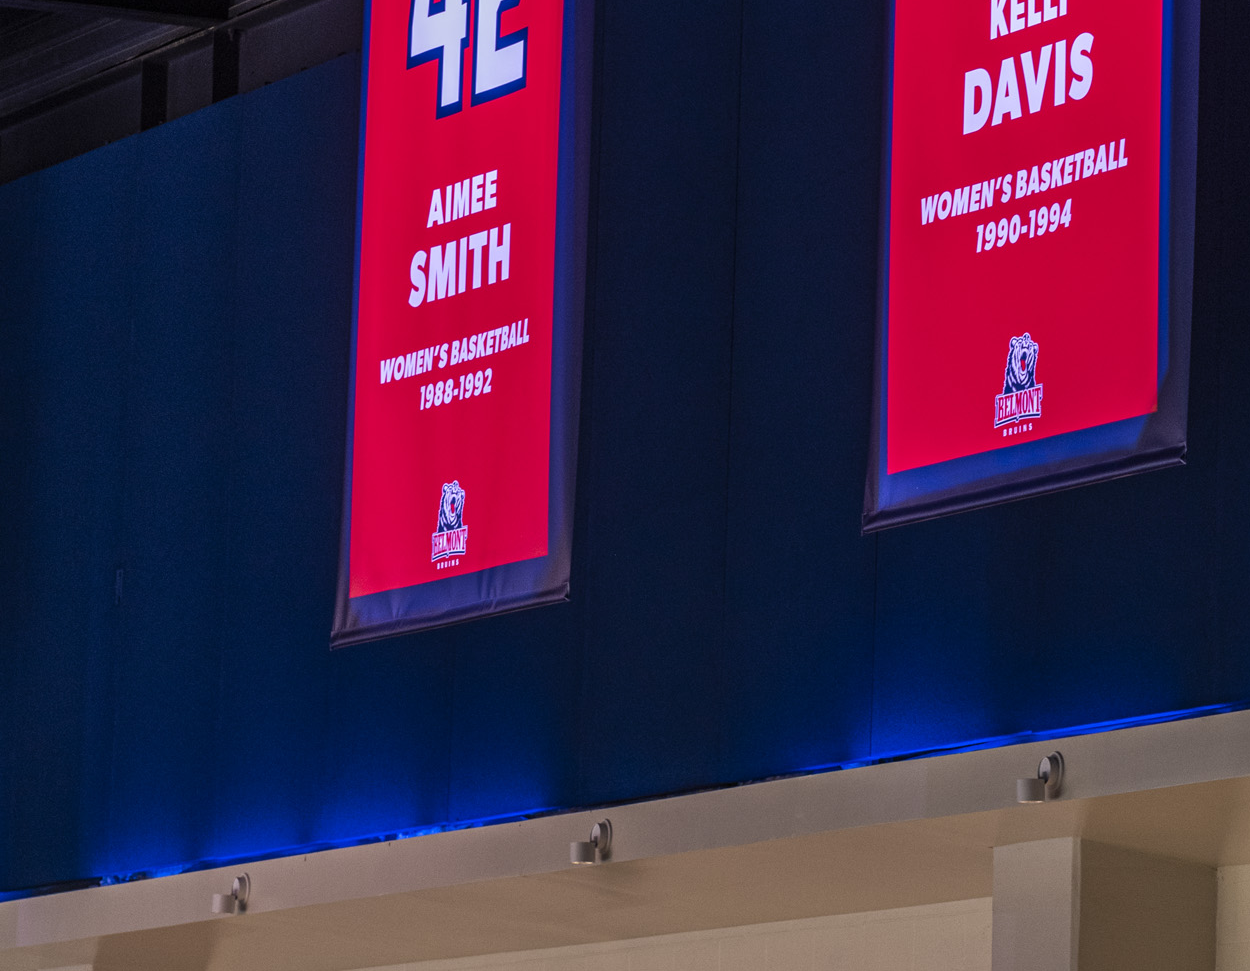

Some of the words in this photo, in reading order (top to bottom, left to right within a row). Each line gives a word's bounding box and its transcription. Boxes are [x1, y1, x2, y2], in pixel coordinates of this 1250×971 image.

[963, 32, 1094, 135] DAVIS
[426, 169, 498, 228] AIMEE
[920, 173, 1013, 226] WOMEN'S
[1015, 138, 1128, 200] BASKETBALL
[976, 198, 1073, 253] 1990-1994
[408, 222, 511, 308] SMITH
[379, 342, 449, 385] WOMEN'S
[449, 318, 530, 366] BASKETBALL
[419, 368, 493, 410] 1988-1992
[997, 385, 1042, 422] BELMONT
[1003, 423, 1033, 437] BRUINS
